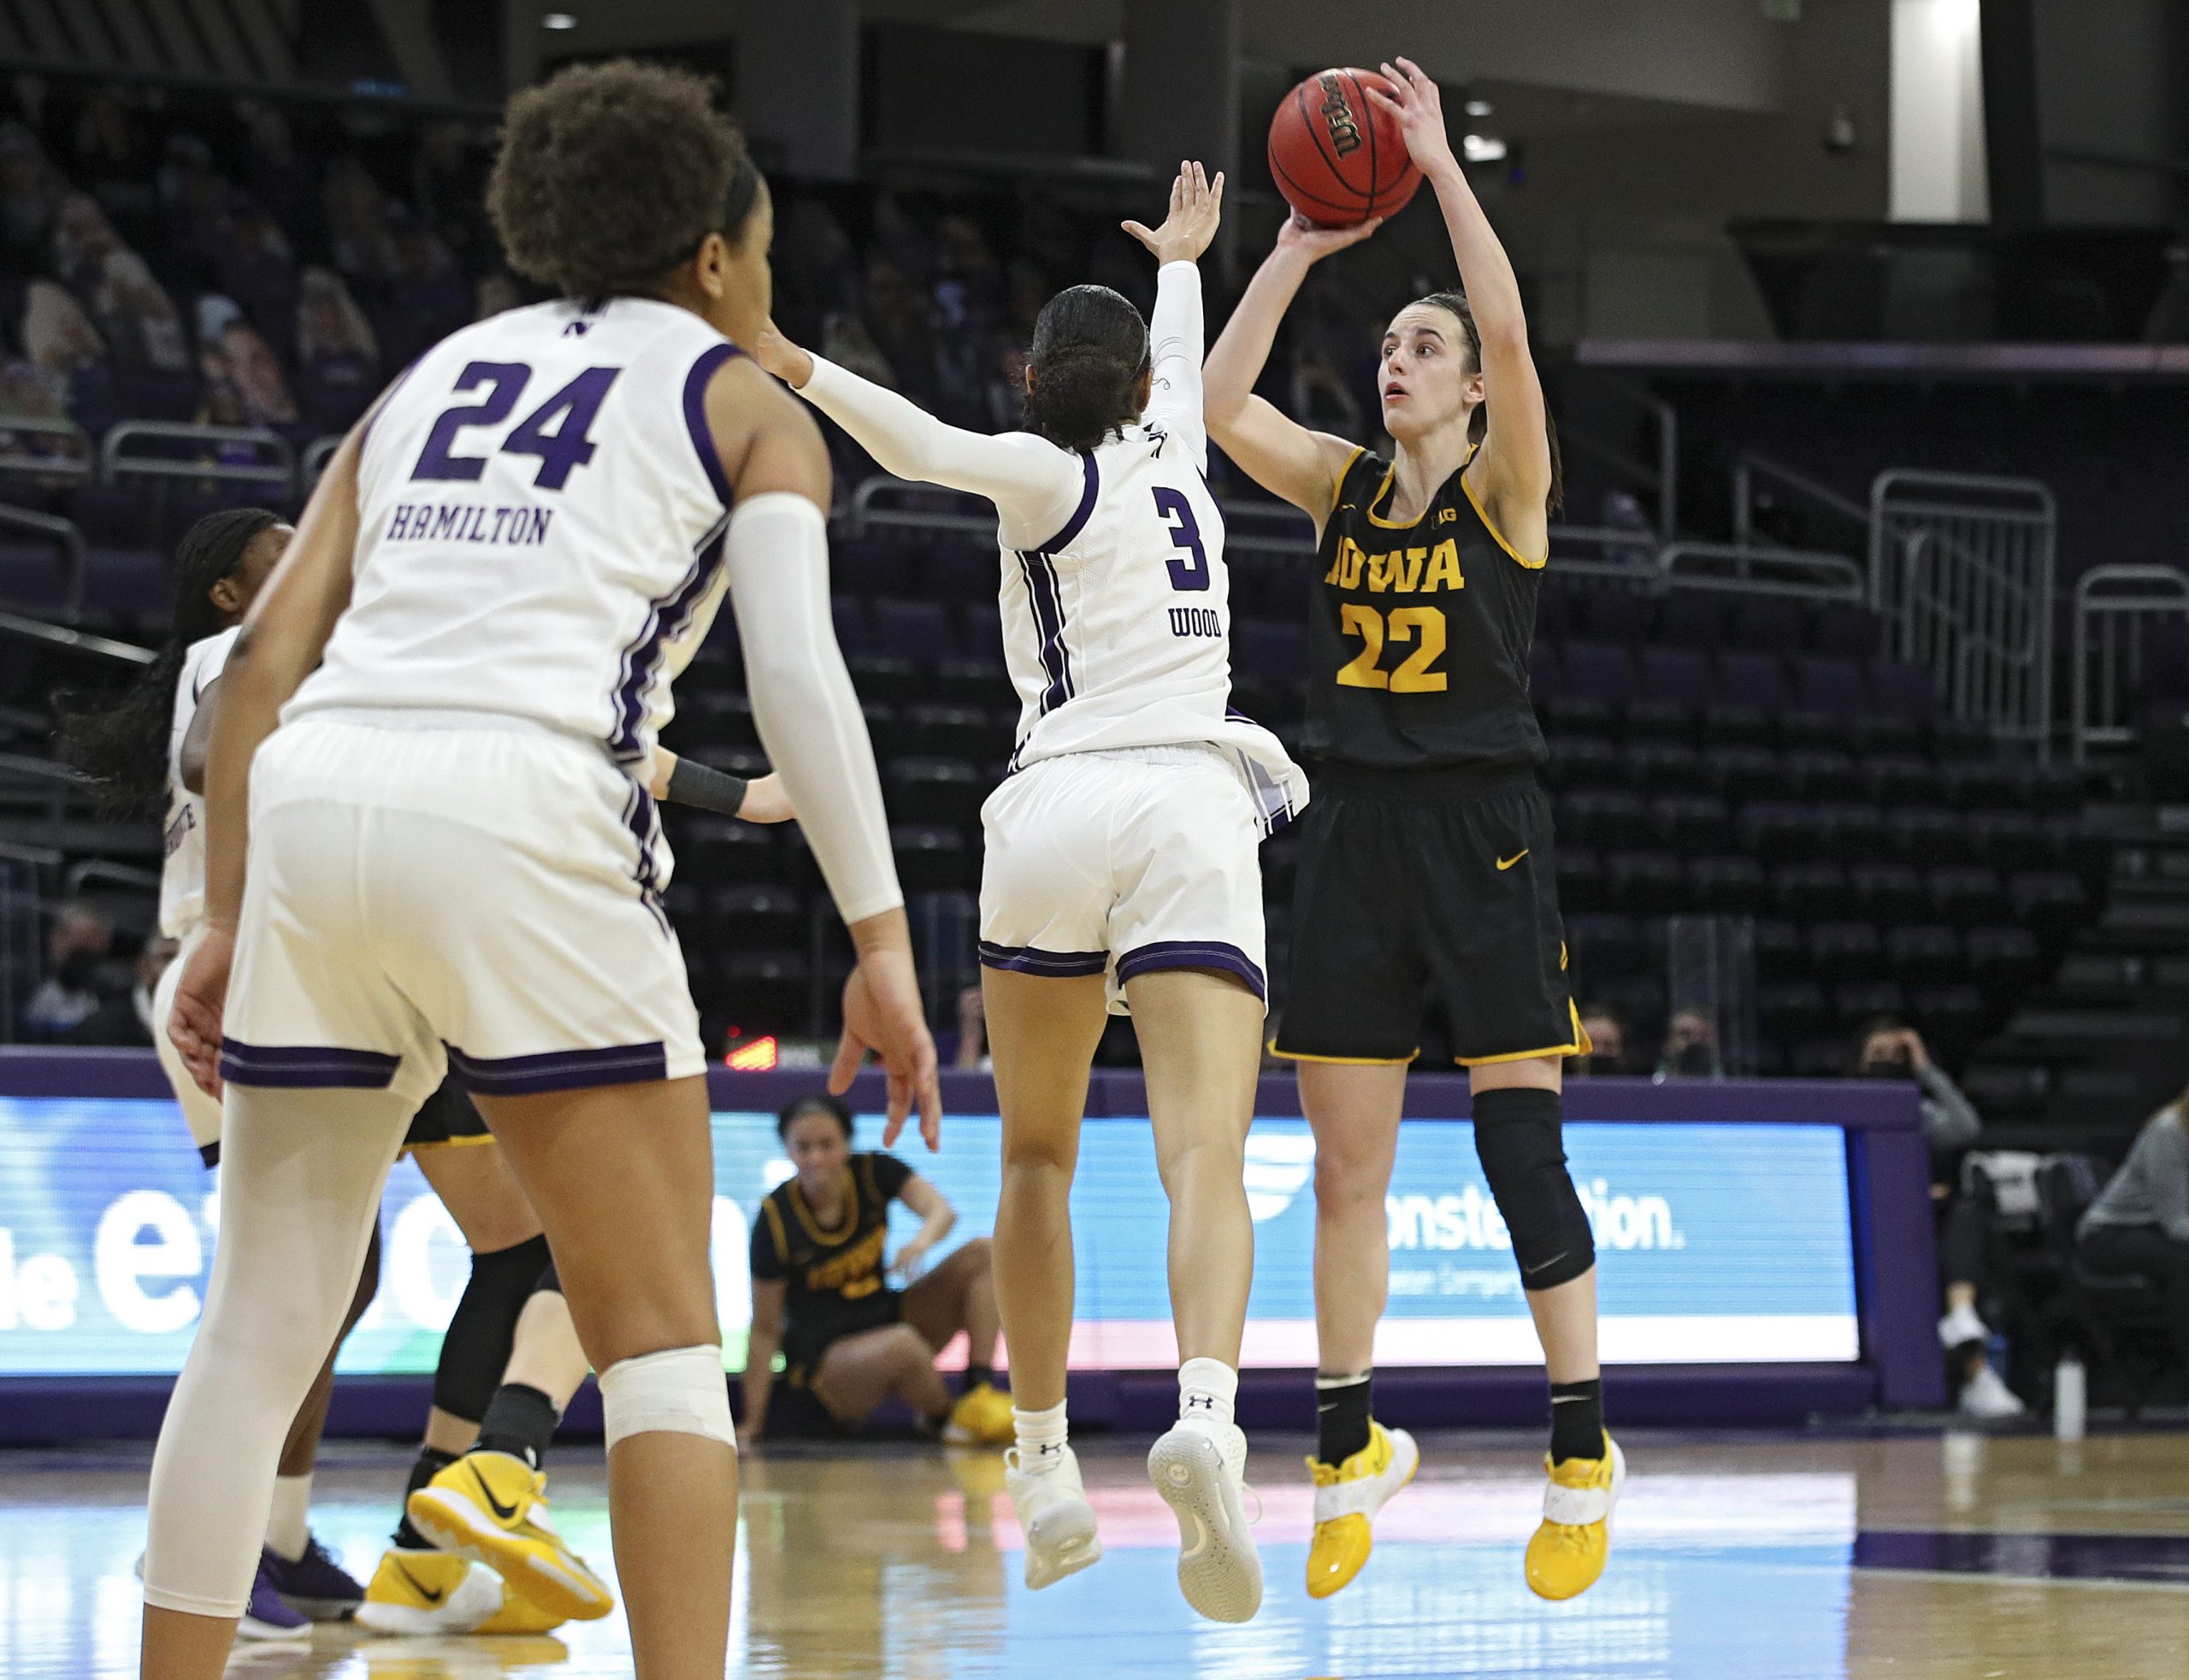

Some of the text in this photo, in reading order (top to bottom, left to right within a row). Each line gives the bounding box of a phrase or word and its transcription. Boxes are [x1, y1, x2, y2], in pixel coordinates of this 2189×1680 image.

[410, 361, 622, 491] 24
[386, 504, 554, 545] HAMILTON
[1151, 486, 1211, 592] 3
[1325, 535, 1465, 593] IOWA
[1167, 608, 1222, 638] WOOD
[1336, 602, 1448, 693] 22
